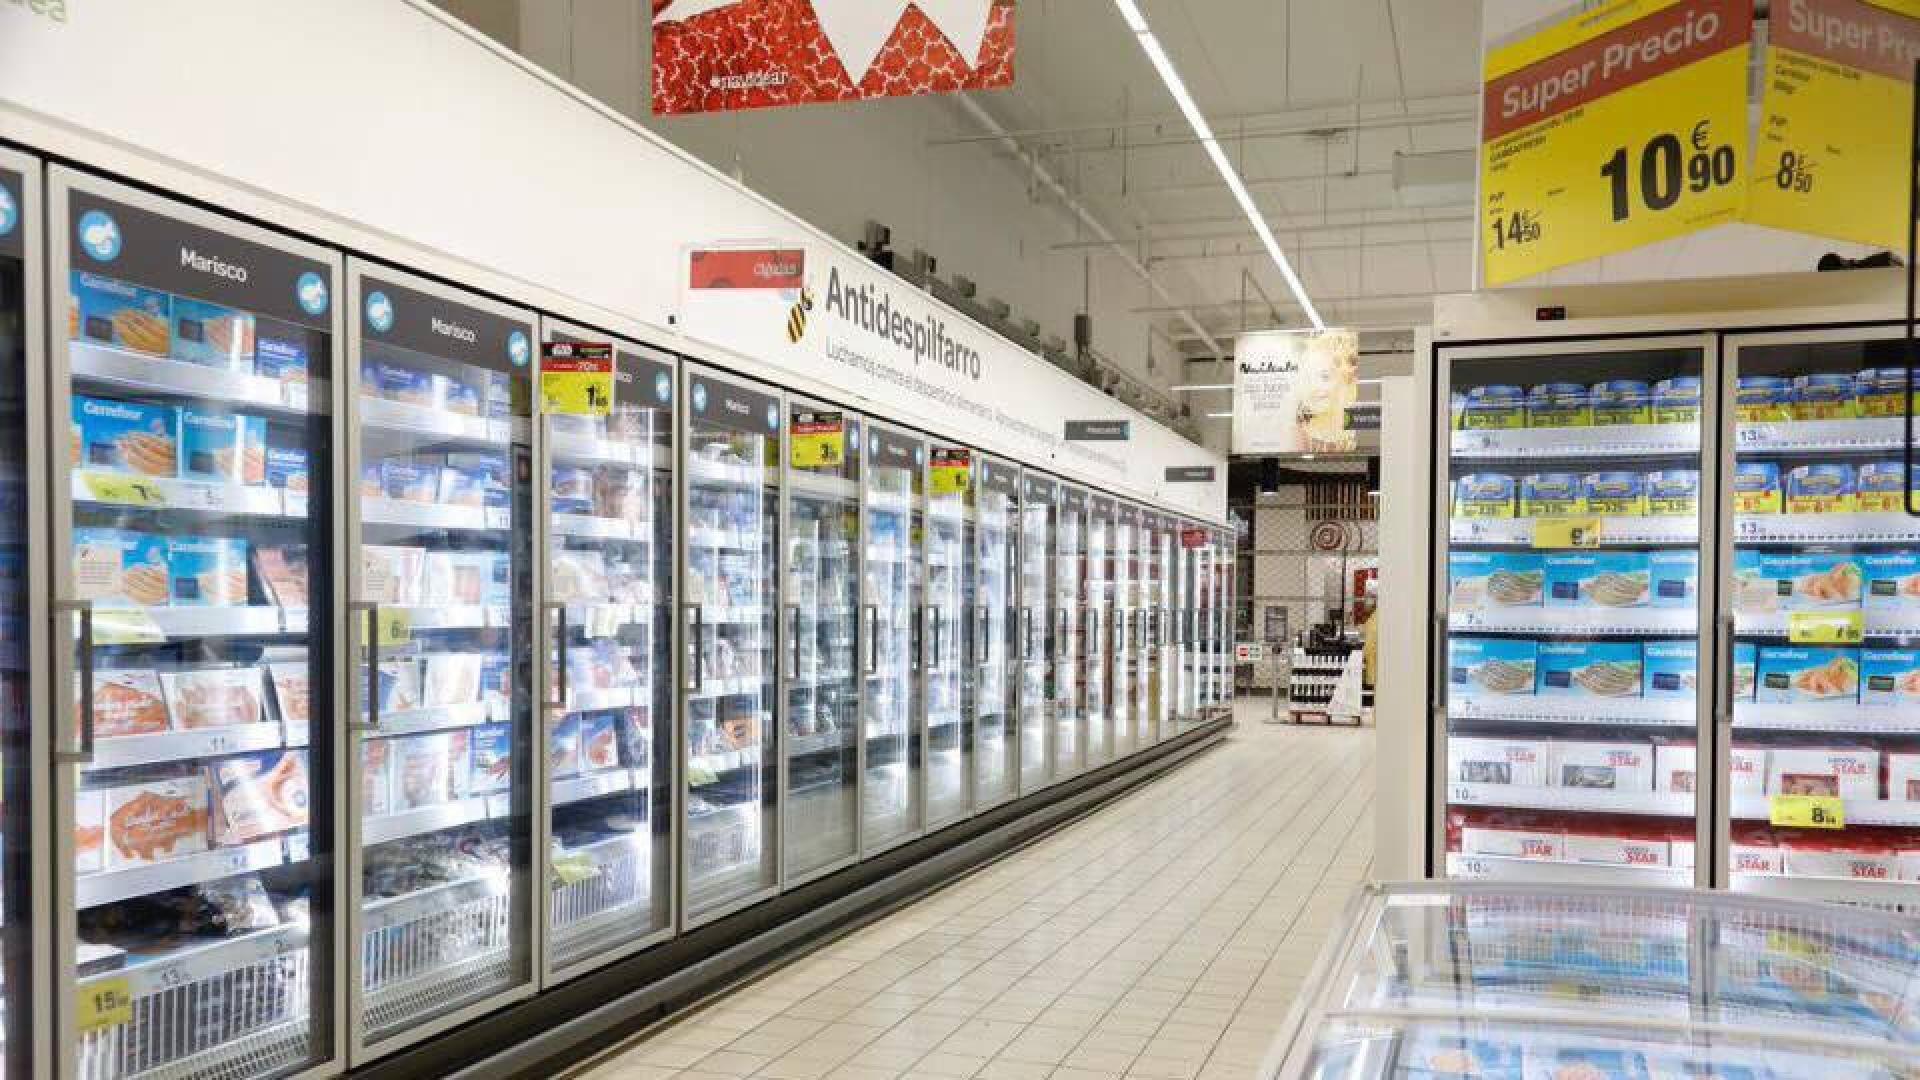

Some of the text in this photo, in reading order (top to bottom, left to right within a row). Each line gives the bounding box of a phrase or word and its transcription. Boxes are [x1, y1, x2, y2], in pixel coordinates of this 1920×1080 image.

[1789, 2, 1873, 49] Super
[1500, 60, 1597, 119] Super
[1603, 9, 1720, 80] Precio
[1601, 133, 1683, 223] 10
[1688, 144, 1736, 193] 90
[181, 247, 248, 283] Marisco
[432, 316, 477, 343] Marisco
[825, 265, 981, 380] Antidespilfarro
